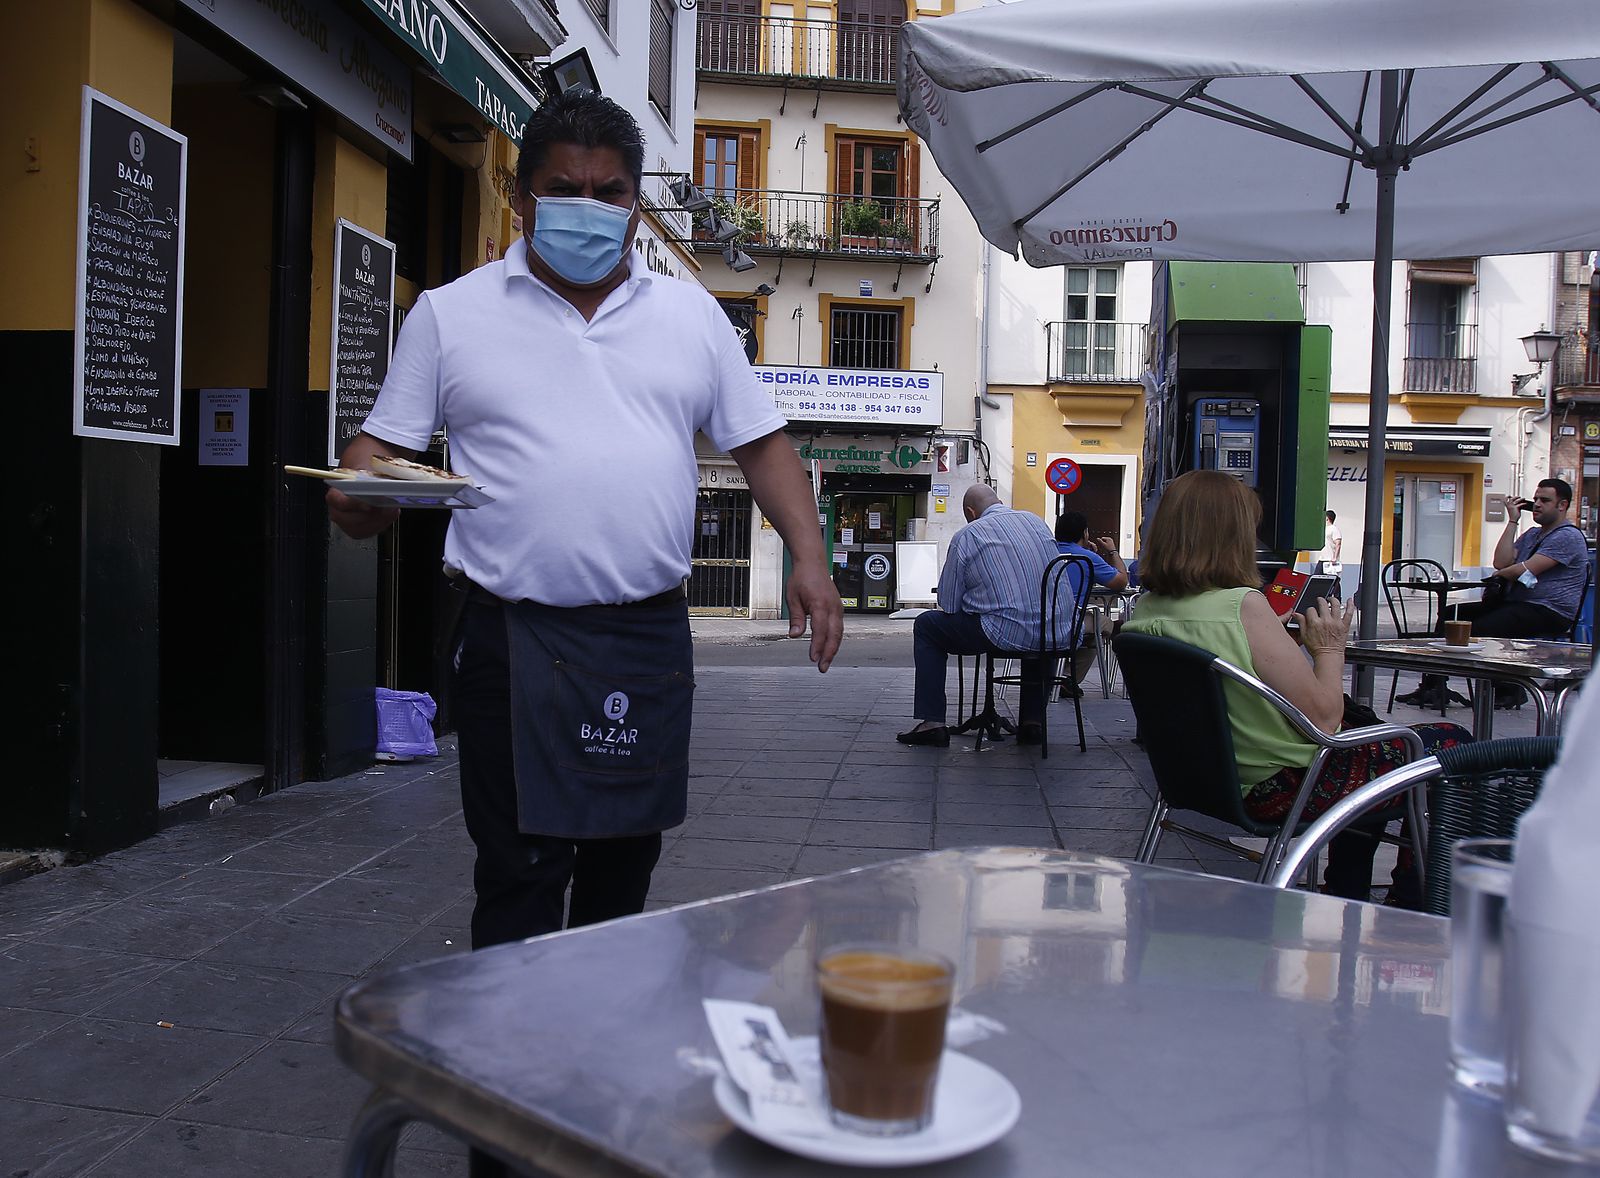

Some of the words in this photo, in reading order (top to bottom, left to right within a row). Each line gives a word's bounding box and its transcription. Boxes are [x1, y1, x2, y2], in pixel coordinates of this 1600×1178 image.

[373, 0, 448, 64] ANO
[118, 162, 153, 191] BAZAR
[355, 267, 375, 286] BAZAR
[827, 374, 930, 389] EMPRESAS
[775, 389, 817, 397] LABORAL
[825, 391, 891, 400] CONTABILIDAD
[899, 393, 931, 401] FISCAL
[775, 400, 796, 409] Tlfns.
[799, 402, 816, 410] 954
[819, 402, 837, 411] 334
[840, 403, 857, 411] 138
[864, 404, 882, 412] 954
[884, 405, 902, 413] 347
[904, 406, 922, 414] 639
[1329, 440, 1360, 448] TABERNA
[800, 443, 883, 462] Carrefour
[835, 464, 881, 474] express
[710, 471, 717, 482] 8
[581, 723, 638, 744] BAZAR
[584, 746, 607, 754] coffee
[617, 748, 631, 756] tea
